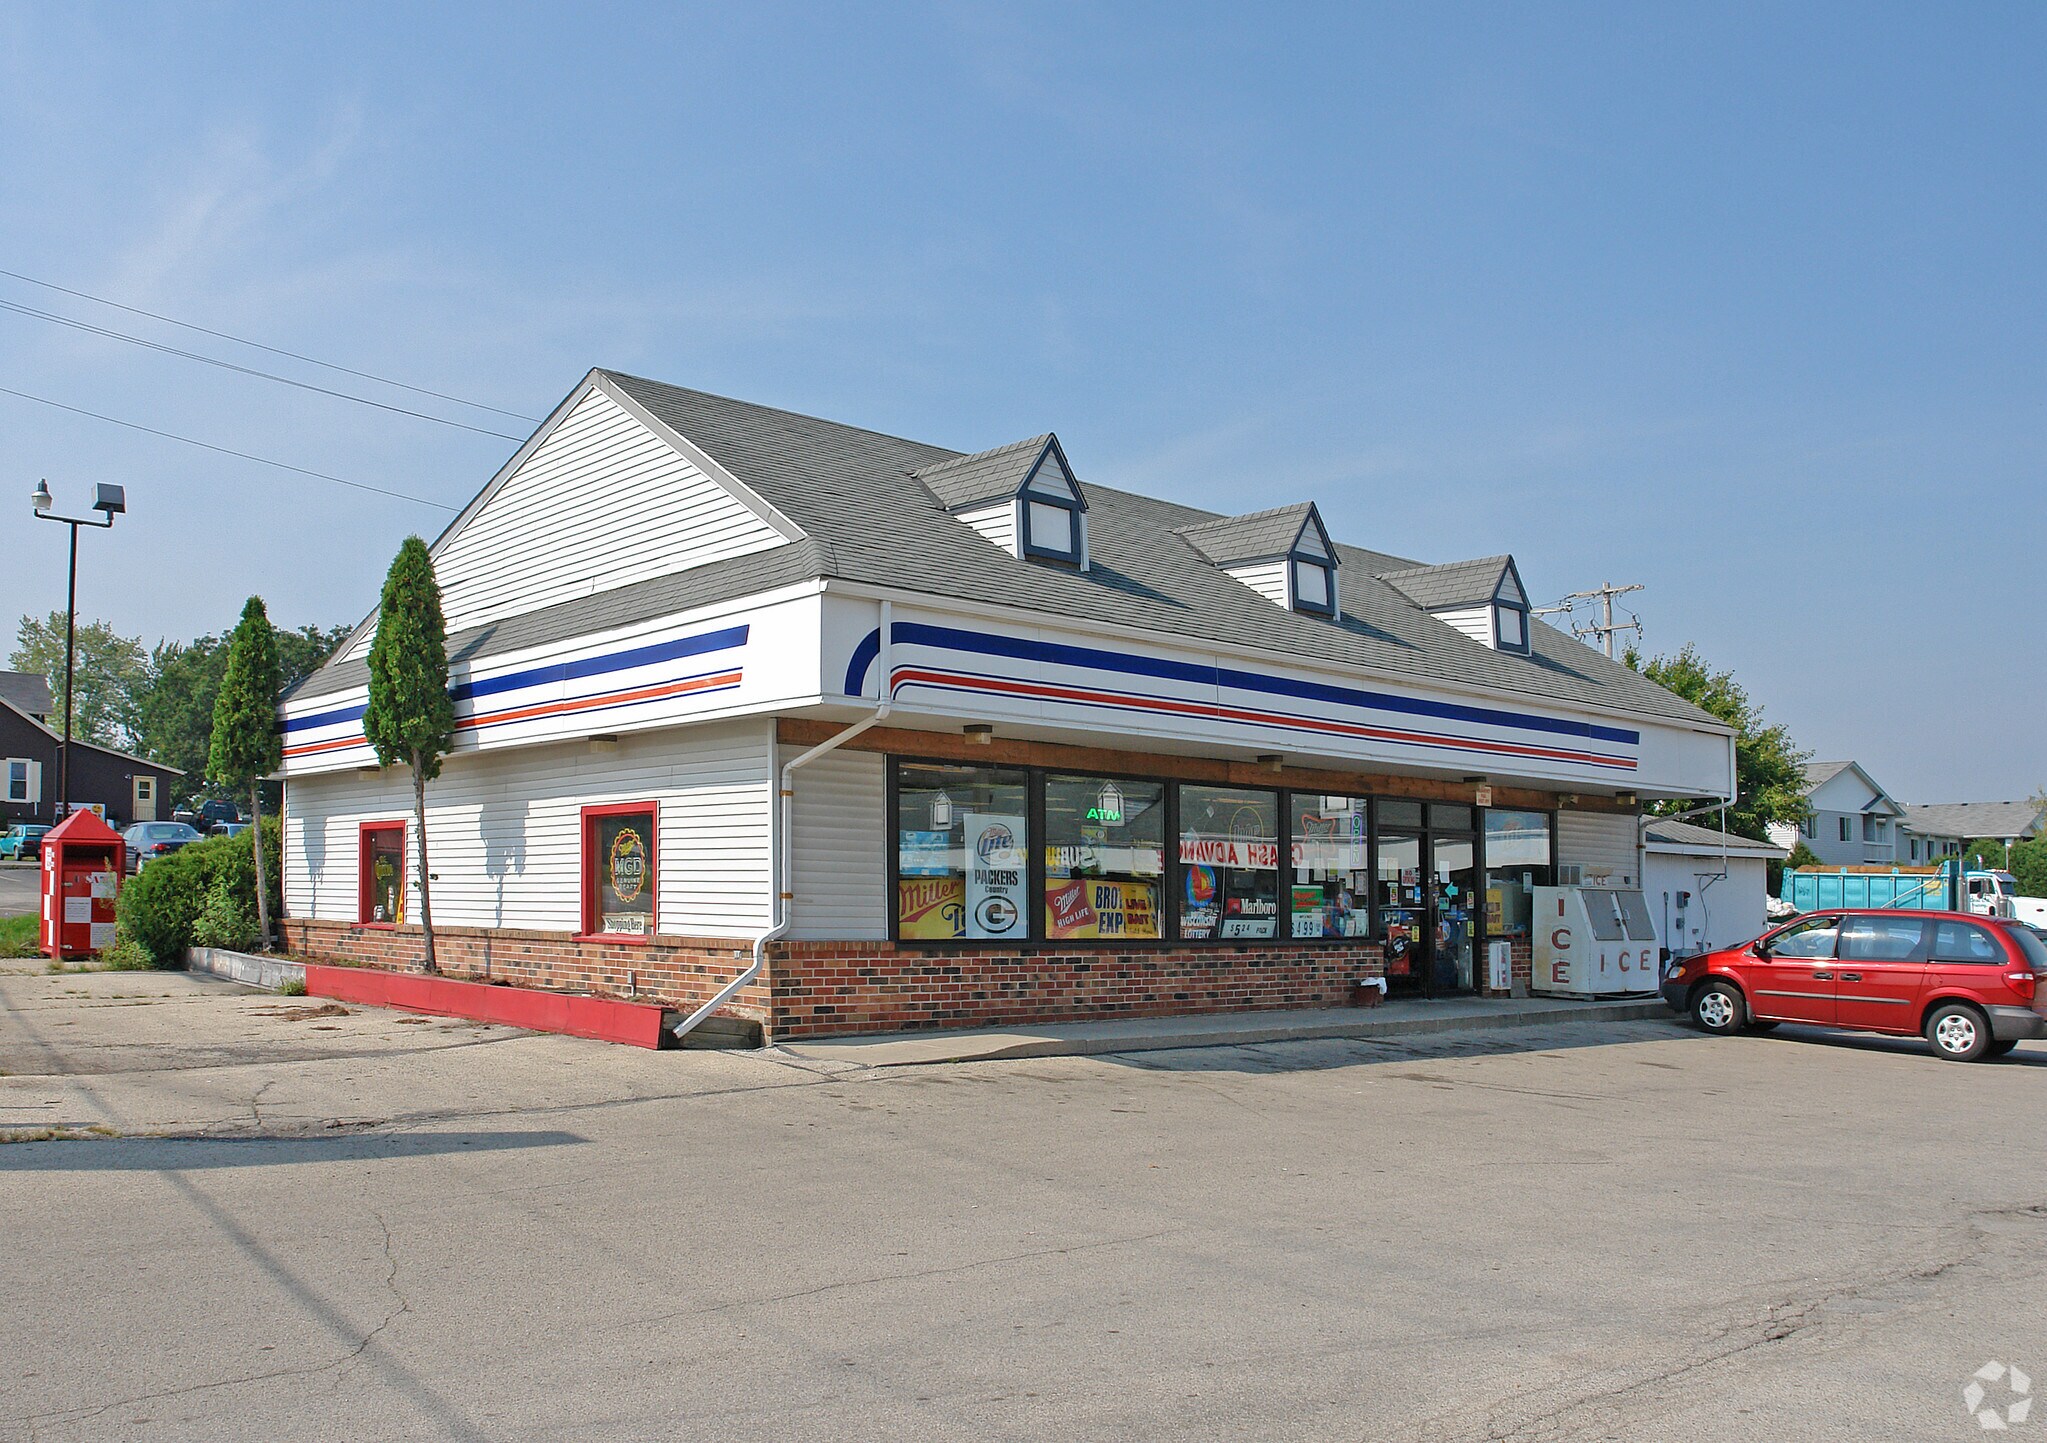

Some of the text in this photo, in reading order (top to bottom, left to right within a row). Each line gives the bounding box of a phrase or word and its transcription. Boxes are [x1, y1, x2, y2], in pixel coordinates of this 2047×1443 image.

[1086, 808, 1121, 821] ATM
[1353, 816, 1361, 863] OPEN
[614, 857, 642, 876] MGD
[974, 869, 1019, 886] PACKERS
[899, 880, 960, 917] Miller
[984, 885, 1009, 894] Country
[1054, 886, 1080, 913] Miller
[1240, 898, 1276, 915] Marlboro
[1057, 907, 1090, 928] HIGH LIFE
[1180, 916, 1217, 927] WISCONSIN
[1184, 929, 1211, 938] LOTTERY
[1599, 950, 1651, 973] ICE
